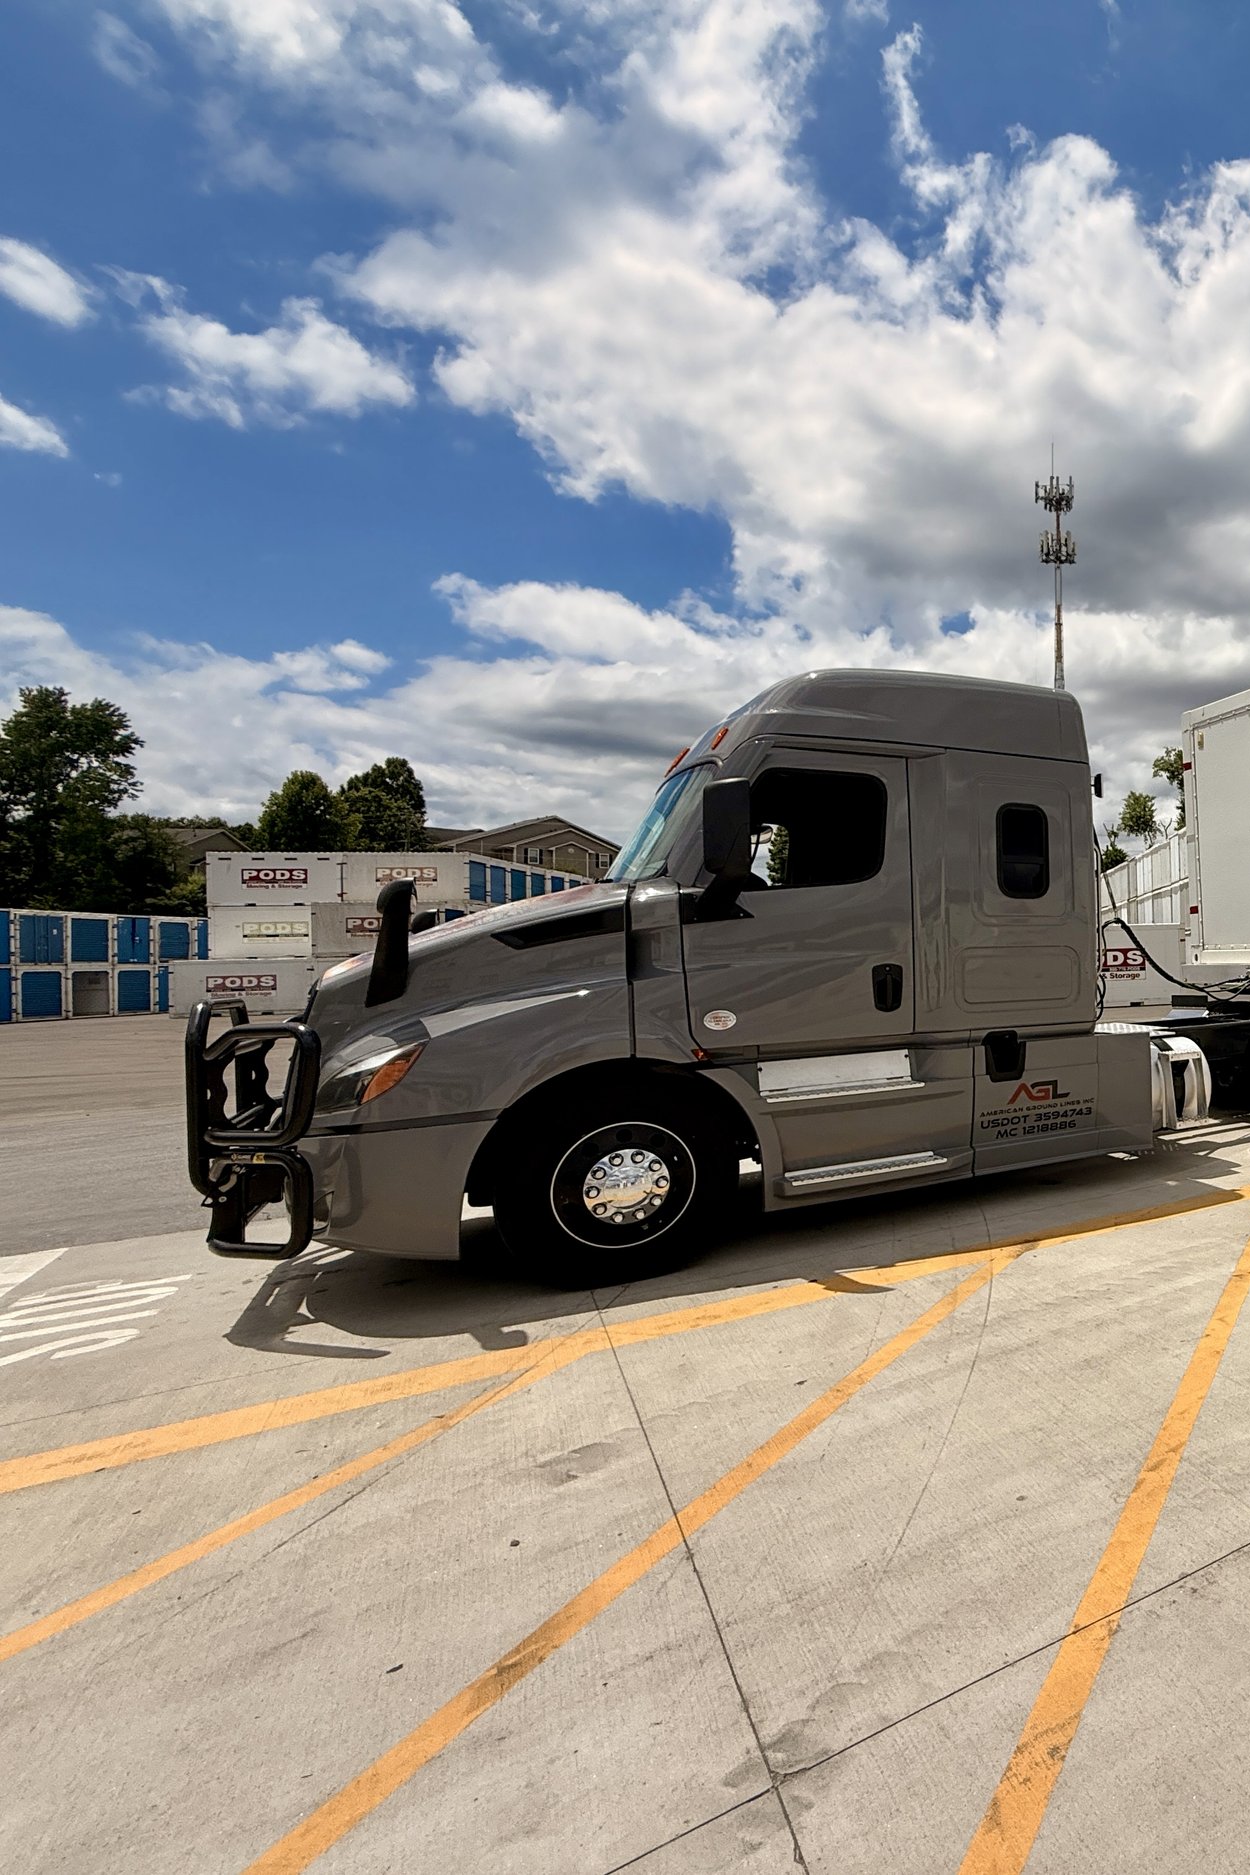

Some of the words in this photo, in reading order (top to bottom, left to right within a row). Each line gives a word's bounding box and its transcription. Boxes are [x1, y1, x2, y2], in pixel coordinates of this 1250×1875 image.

[243, 870, 306, 880] PODS
[377, 868, 436, 878] PODS
[243, 922, 308, 934] PODS
[1101, 950, 1144, 966] DS
[208, 976, 275, 988] PODS
[1110, 972, 1140, 980] Storage
[1007, 1079, 1071, 1105] AGL
[980, 1107, 1024, 1118] AMERICAN
[1026, 1103, 1058, 1112] GROUND
[980, 1115, 1030, 1130] USDOT
[1034, 1107, 1092, 1122] 3594743
[996, 1128, 1018, 1139] MC
[1022, 1120, 1077, 1135] 1218886
